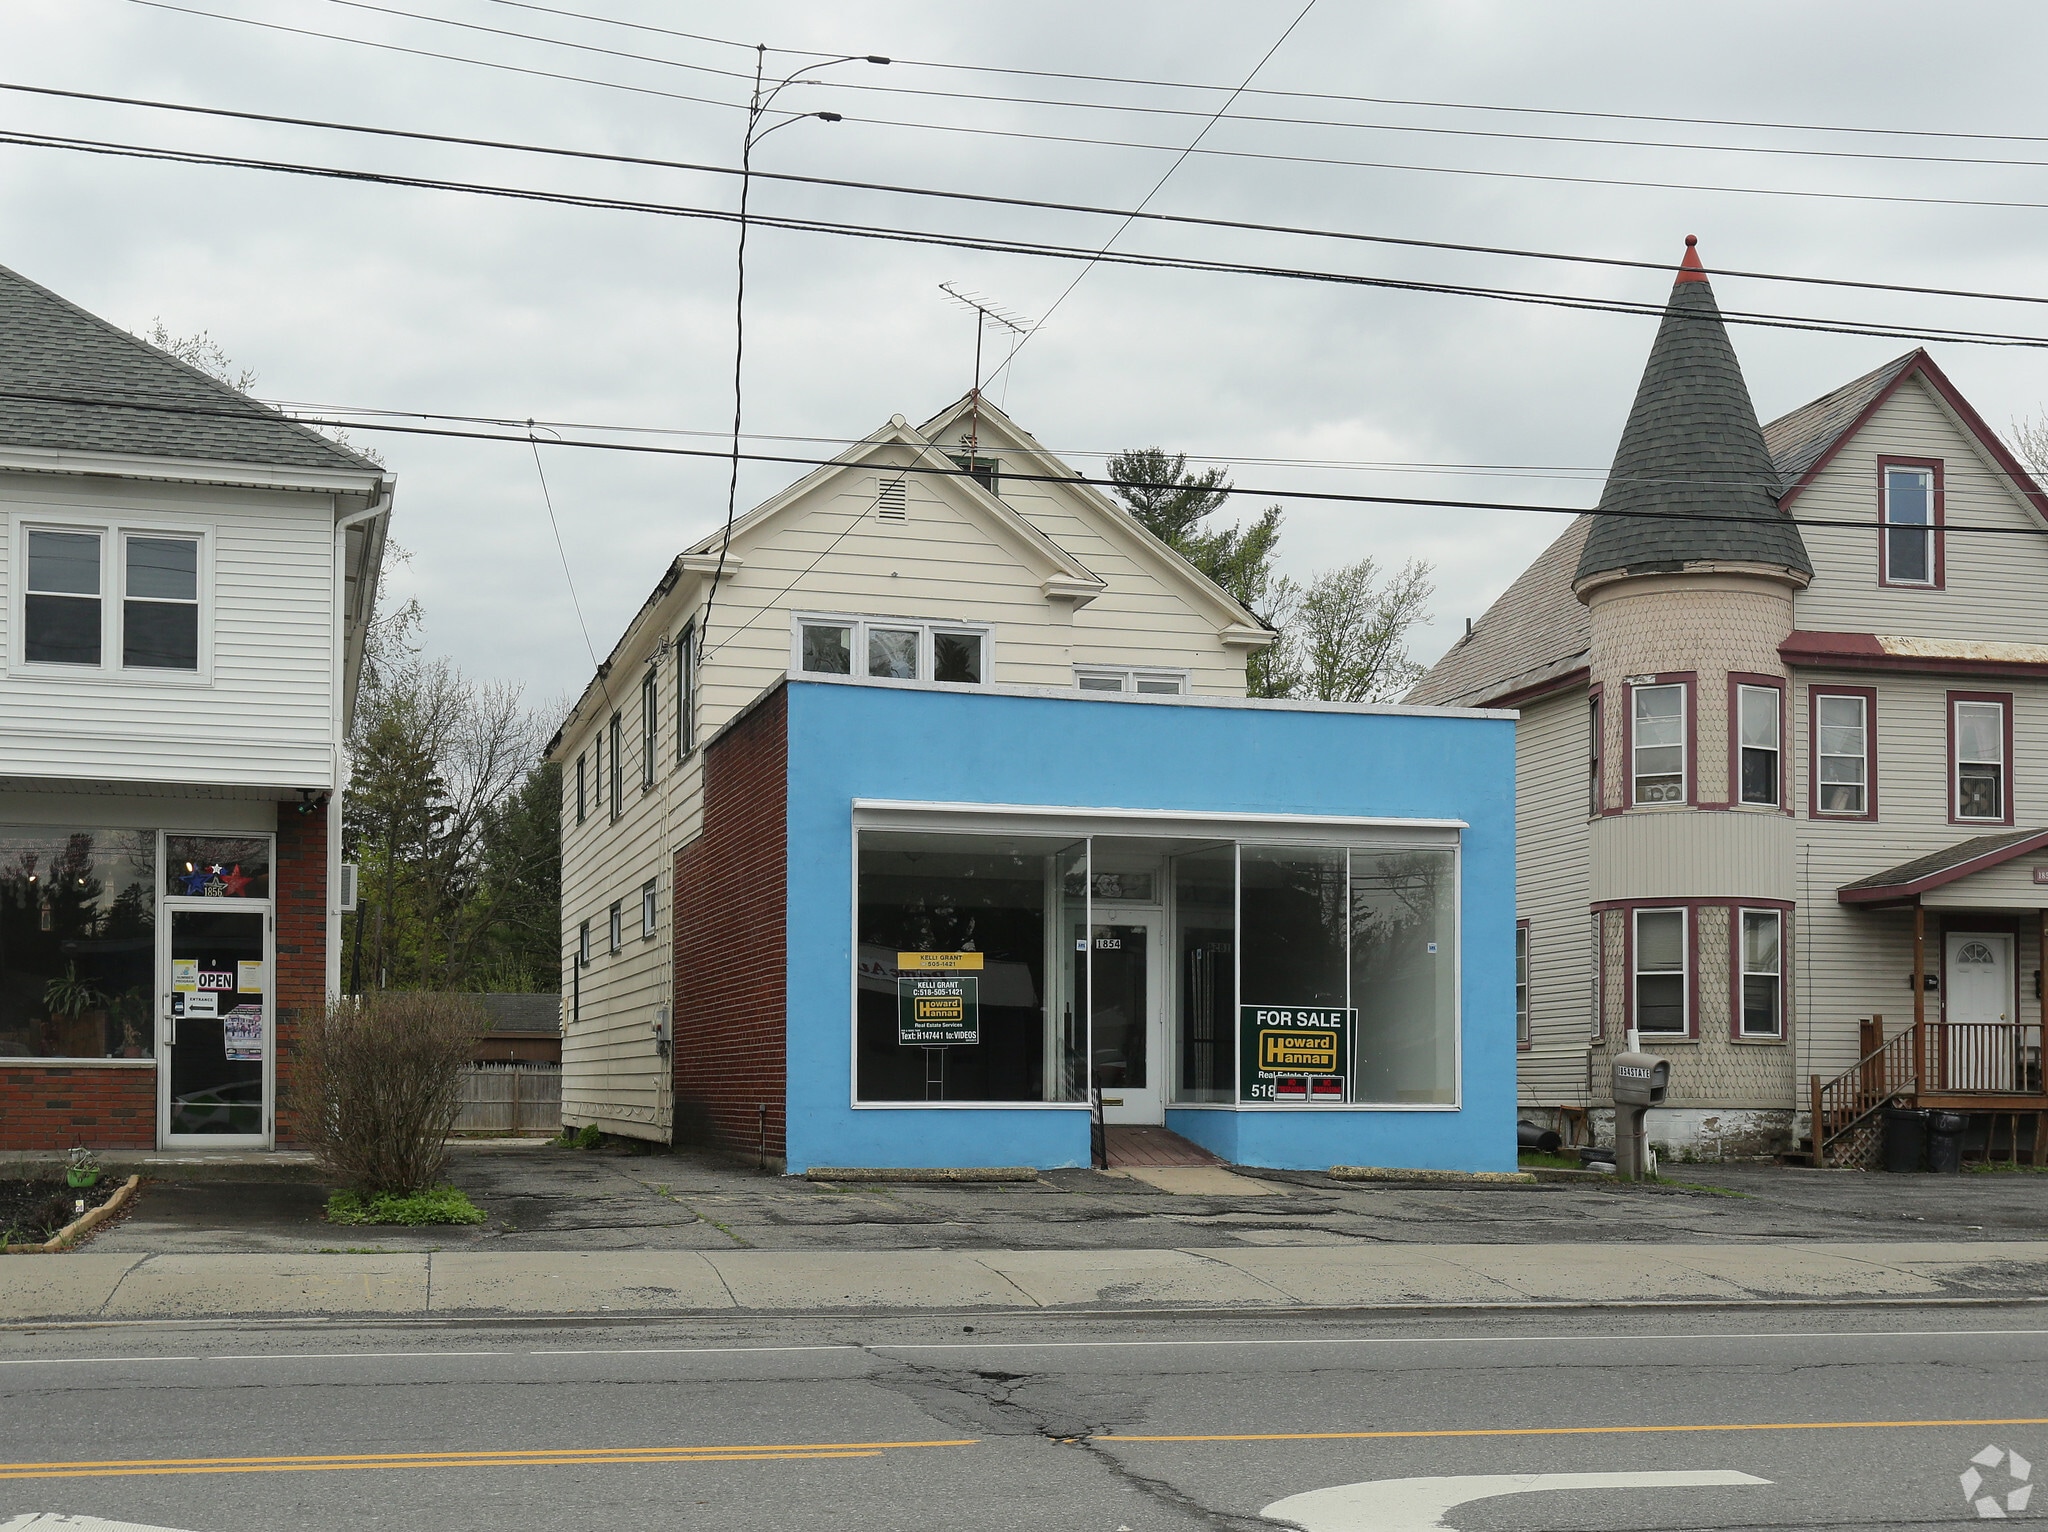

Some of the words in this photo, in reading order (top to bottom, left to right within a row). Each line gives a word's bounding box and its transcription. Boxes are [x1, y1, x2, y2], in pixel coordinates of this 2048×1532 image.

[204, 887, 223, 897] 1856
[1097, 940, 1120, 949] 1854
[199, 973, 232, 988] OPEN
[1257, 1011, 1292, 1026] FOR
[1297, 1012, 1341, 1028] SALE
